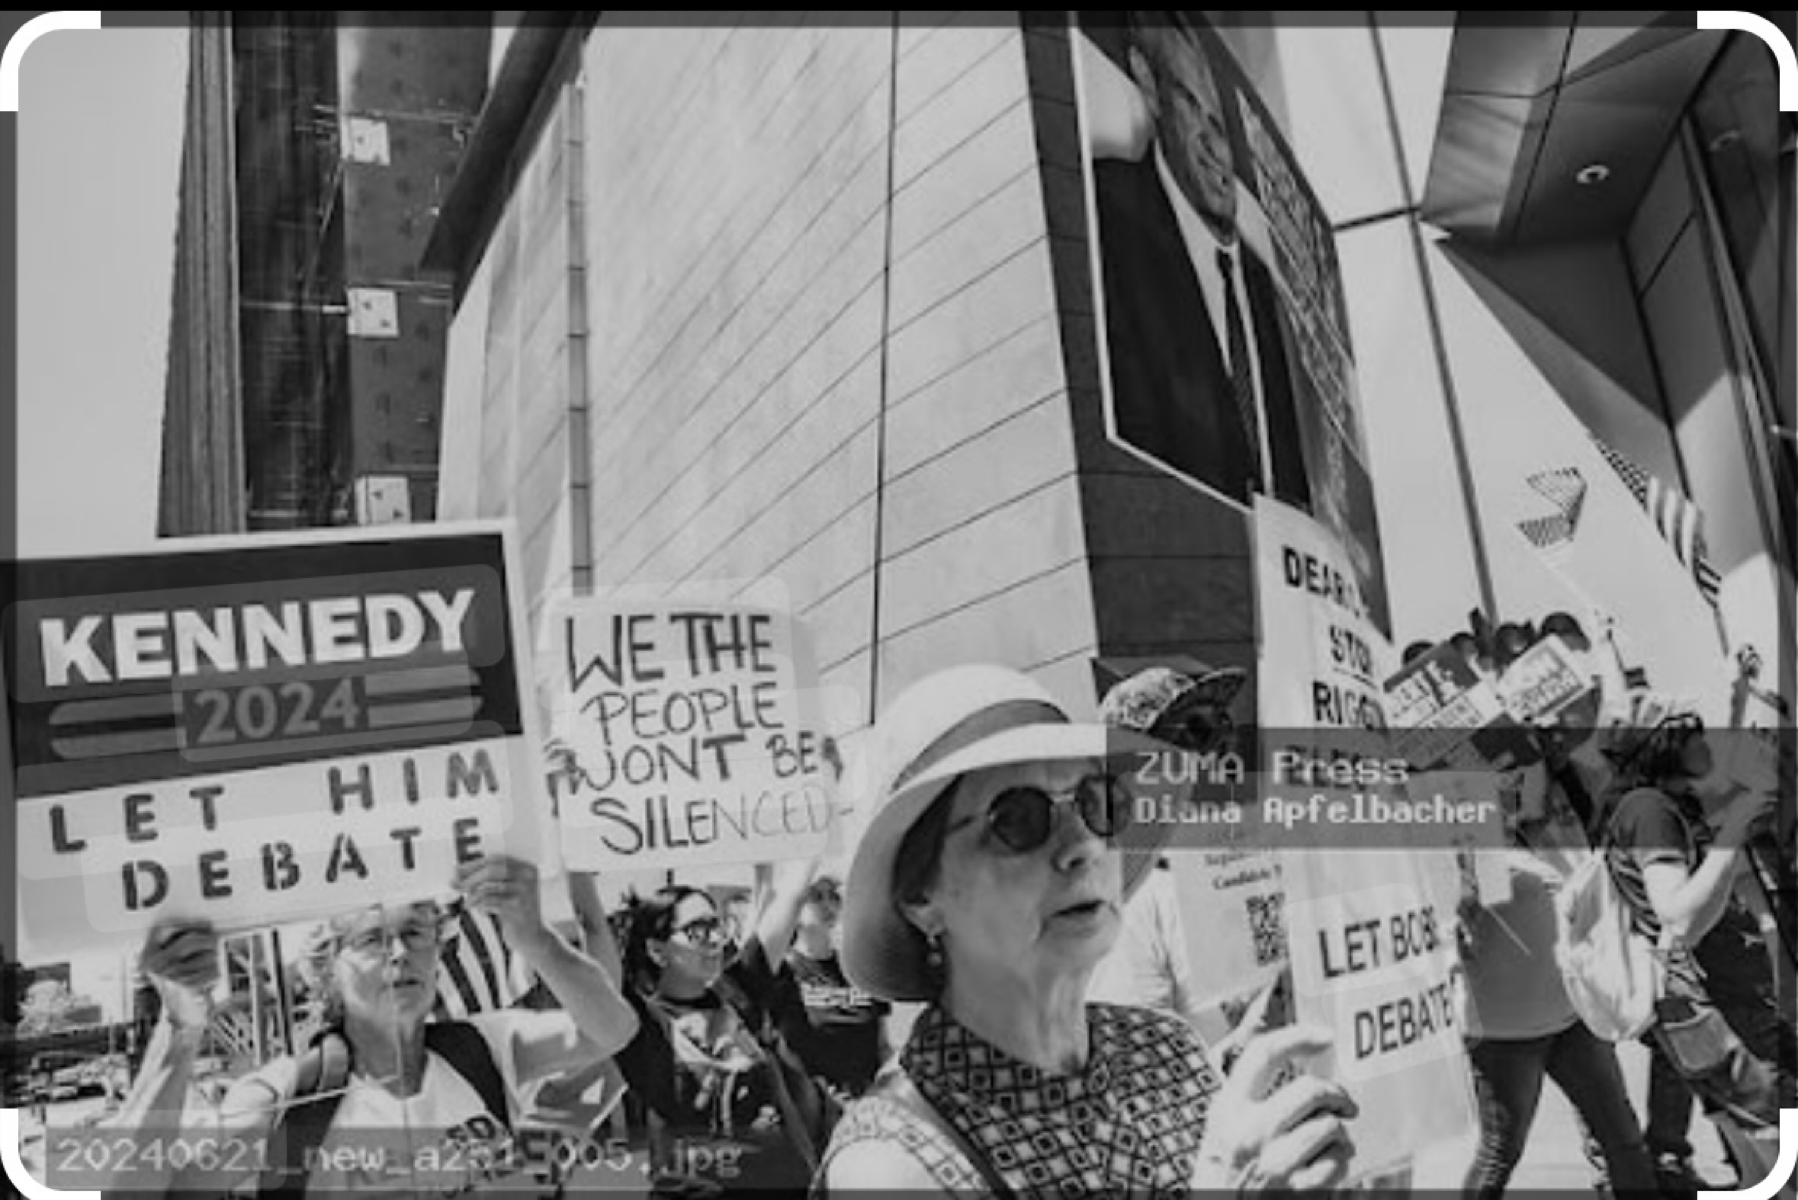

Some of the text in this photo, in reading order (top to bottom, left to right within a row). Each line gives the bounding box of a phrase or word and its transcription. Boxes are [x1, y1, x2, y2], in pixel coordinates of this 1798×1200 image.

[40, 589, 475, 687] KENNEDY
[566, 612, 776, 693] WE THE
[194, 677, 361, 743] 2024
[580, 681, 784, 747] PEOPLE
[764, 730, 818, 779] BE
[49, 747, 499, 855] LET HIM
[590, 782, 832, 856] SILENCED
[121, 818, 486, 911] DEBATE
[1318, 918, 1381, 979] LET
